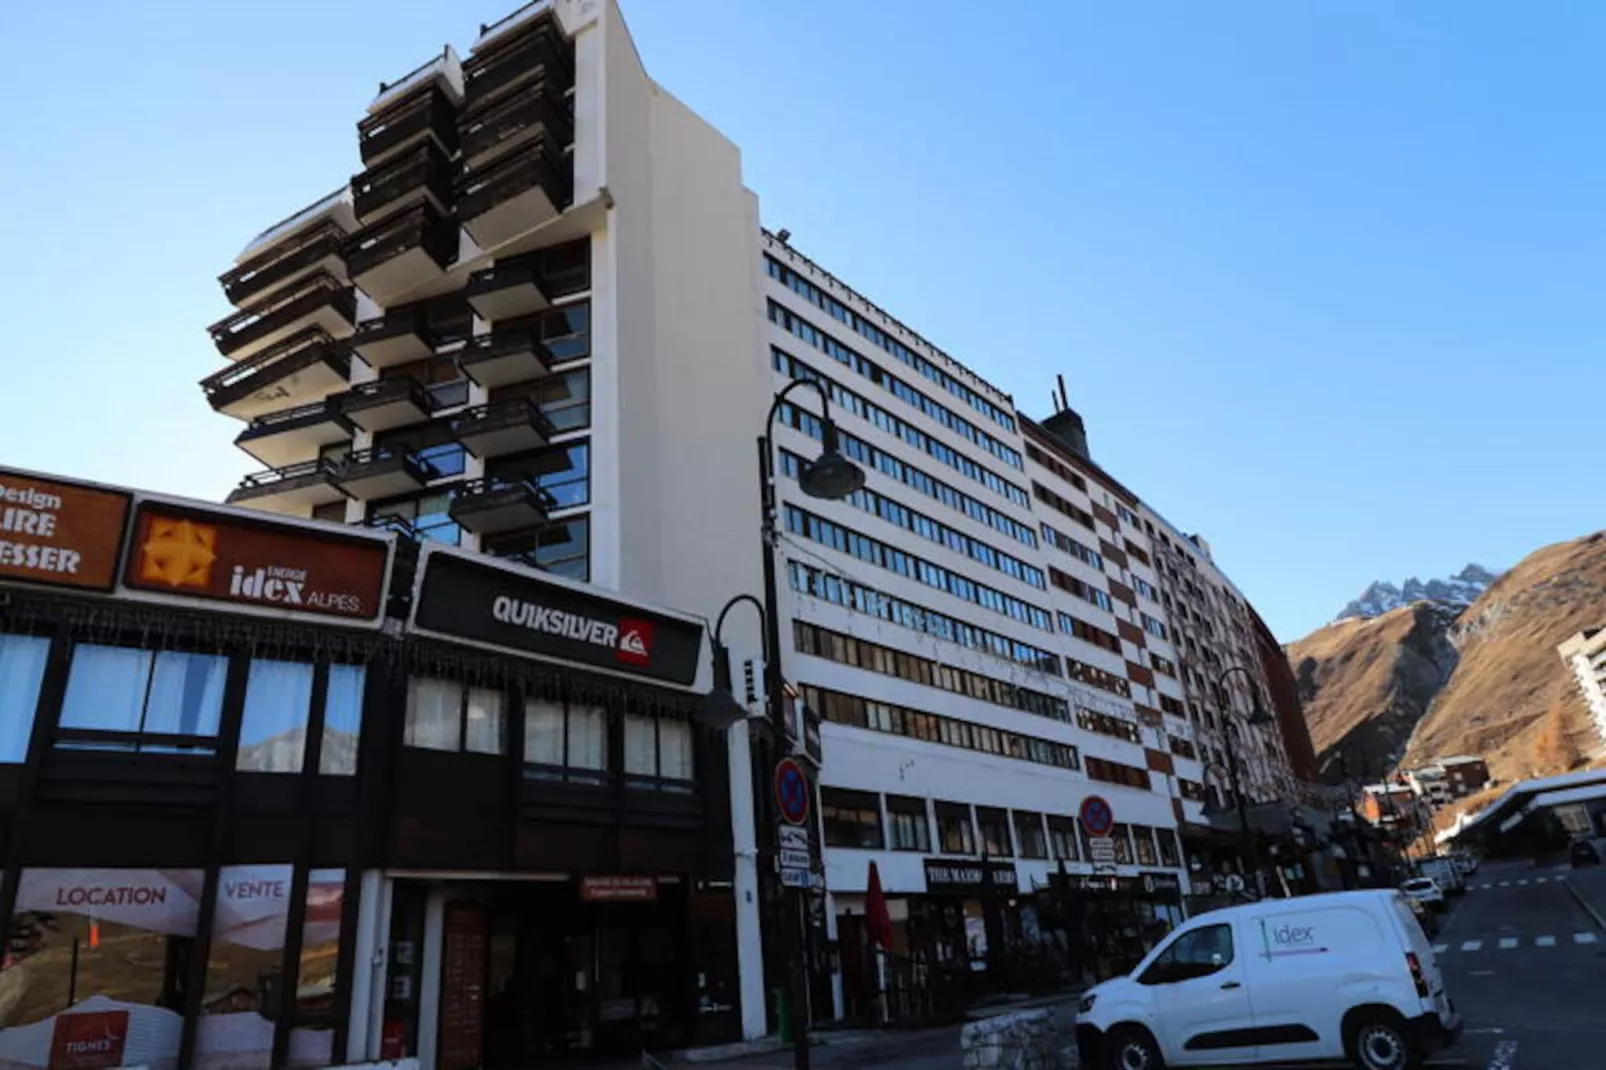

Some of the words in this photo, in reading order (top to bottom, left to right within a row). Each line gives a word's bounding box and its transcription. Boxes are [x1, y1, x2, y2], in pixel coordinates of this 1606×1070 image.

[230, 564, 305, 604] idex
[307, 588, 361, 612] ALPES
[492, 595, 618, 649] QUIKSILVER
[56, 886, 167, 906] LOCATION
[225, 880, 285, 898] VENTE
[1272, 923, 1316, 945] idex
